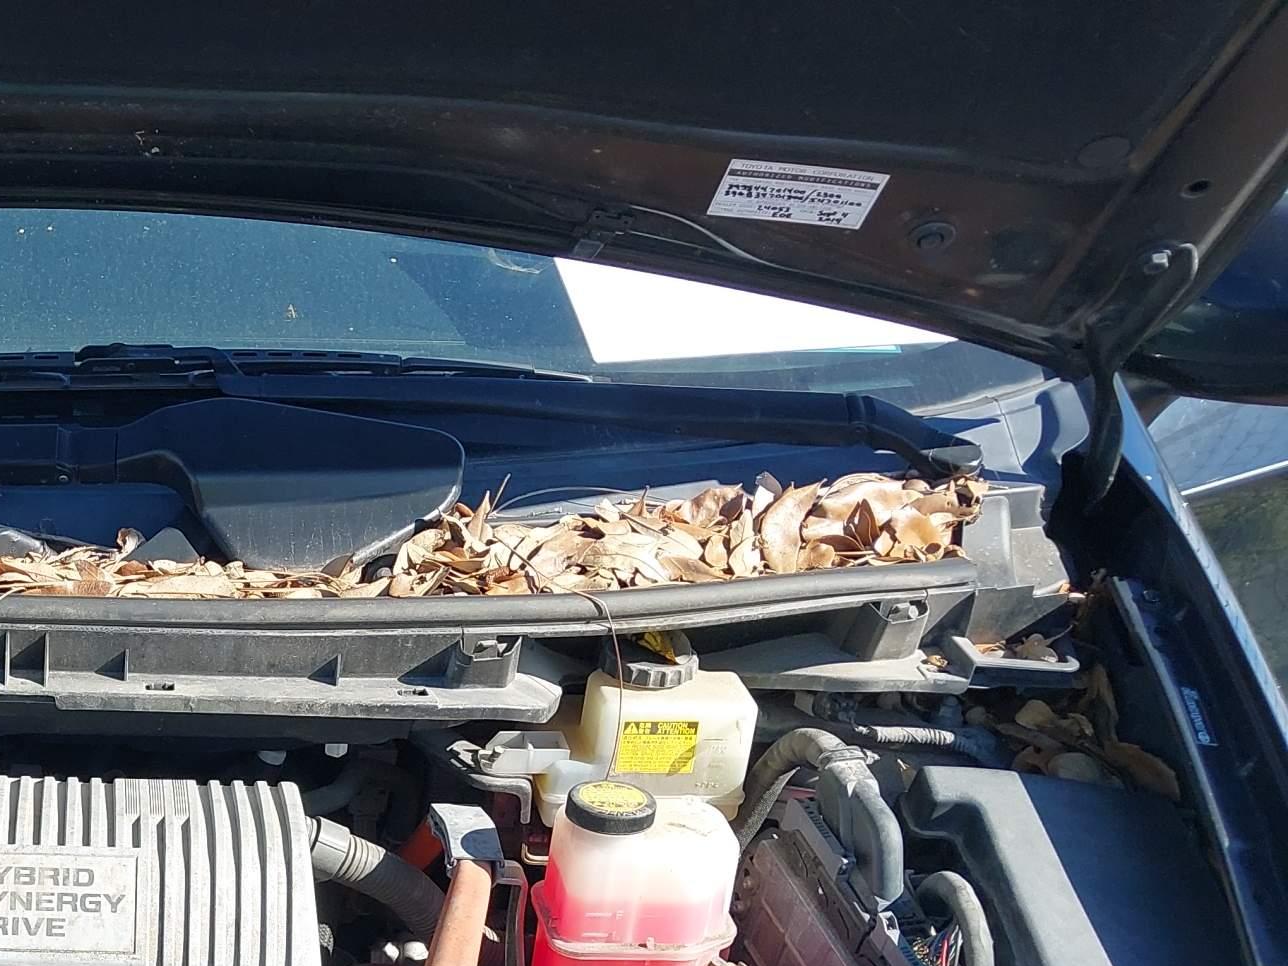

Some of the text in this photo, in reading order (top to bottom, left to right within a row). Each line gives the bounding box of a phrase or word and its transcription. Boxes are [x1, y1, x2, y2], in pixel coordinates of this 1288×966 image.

[740, 162, 875, 182] TOYOTA MOTOR CORPORATION
